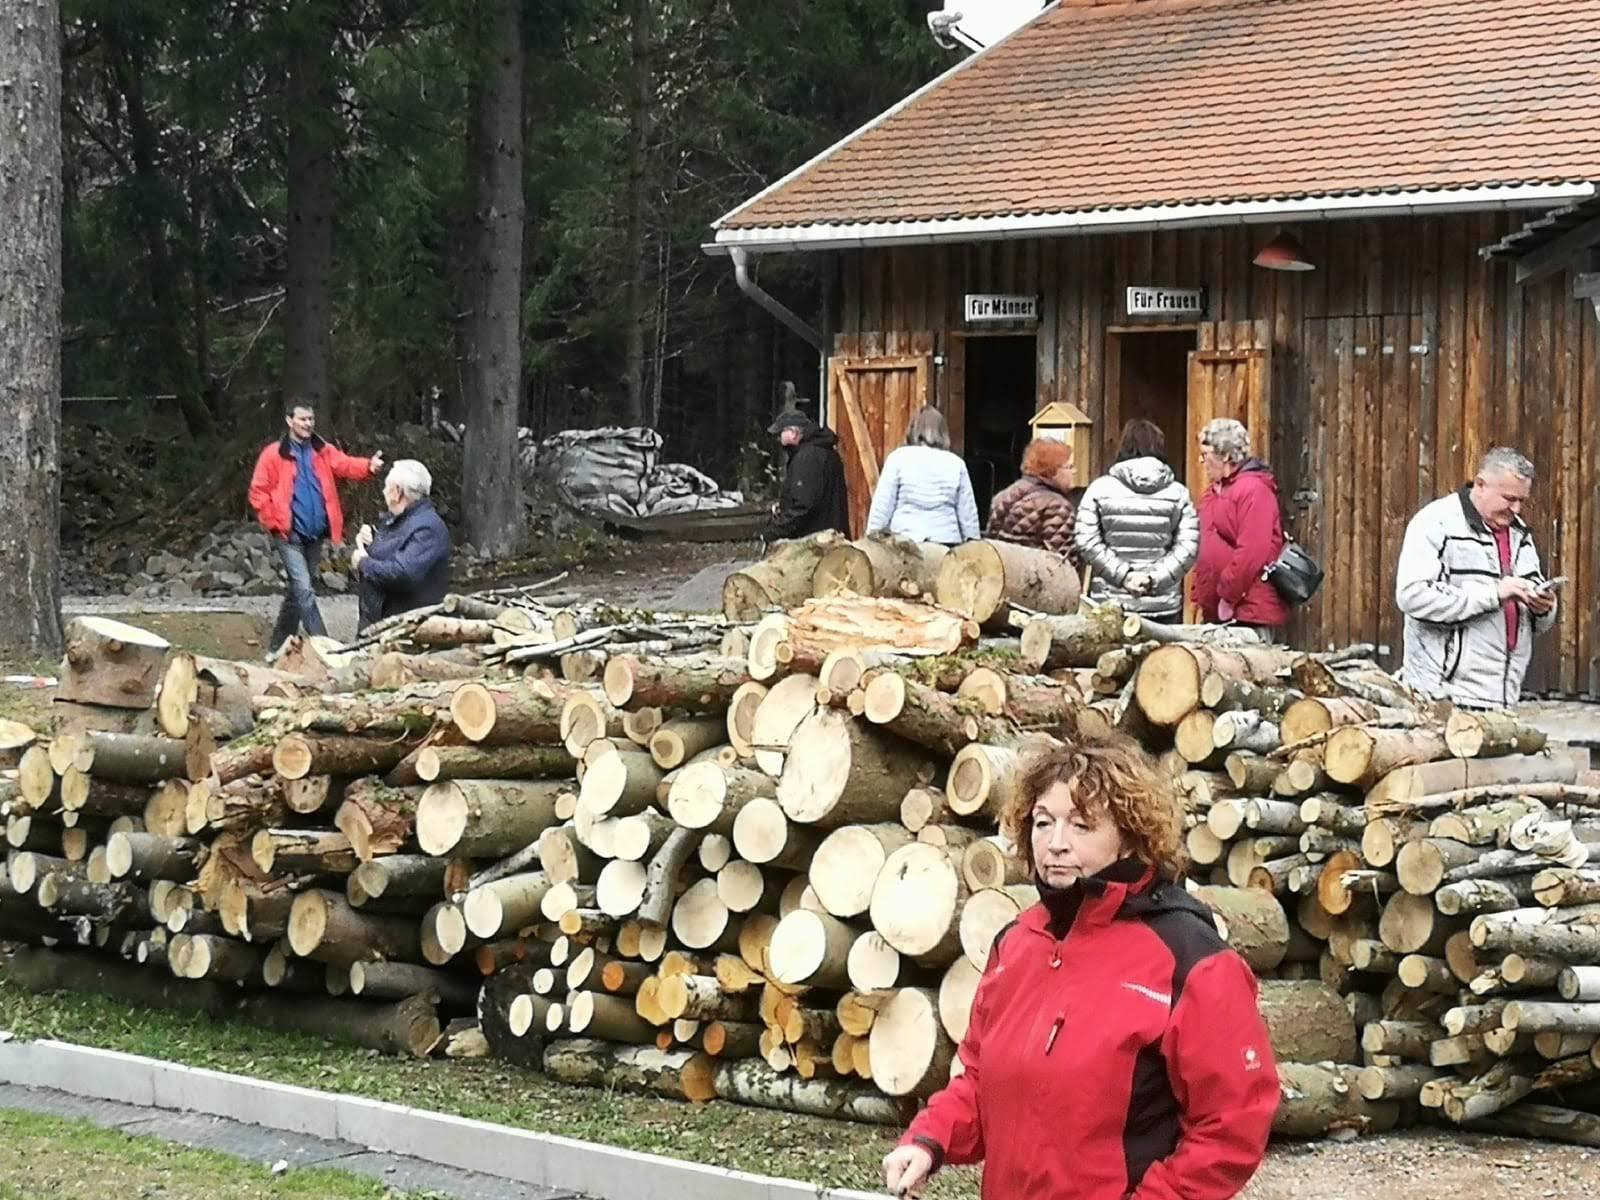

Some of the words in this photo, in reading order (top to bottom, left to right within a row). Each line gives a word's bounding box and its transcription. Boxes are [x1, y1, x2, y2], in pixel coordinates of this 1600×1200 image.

[971, 299, 990, 315] Für
[992, 298, 1033, 316] Männer
[1134, 291, 1152, 308] Für
[1156, 291, 1198, 309] Frauen
